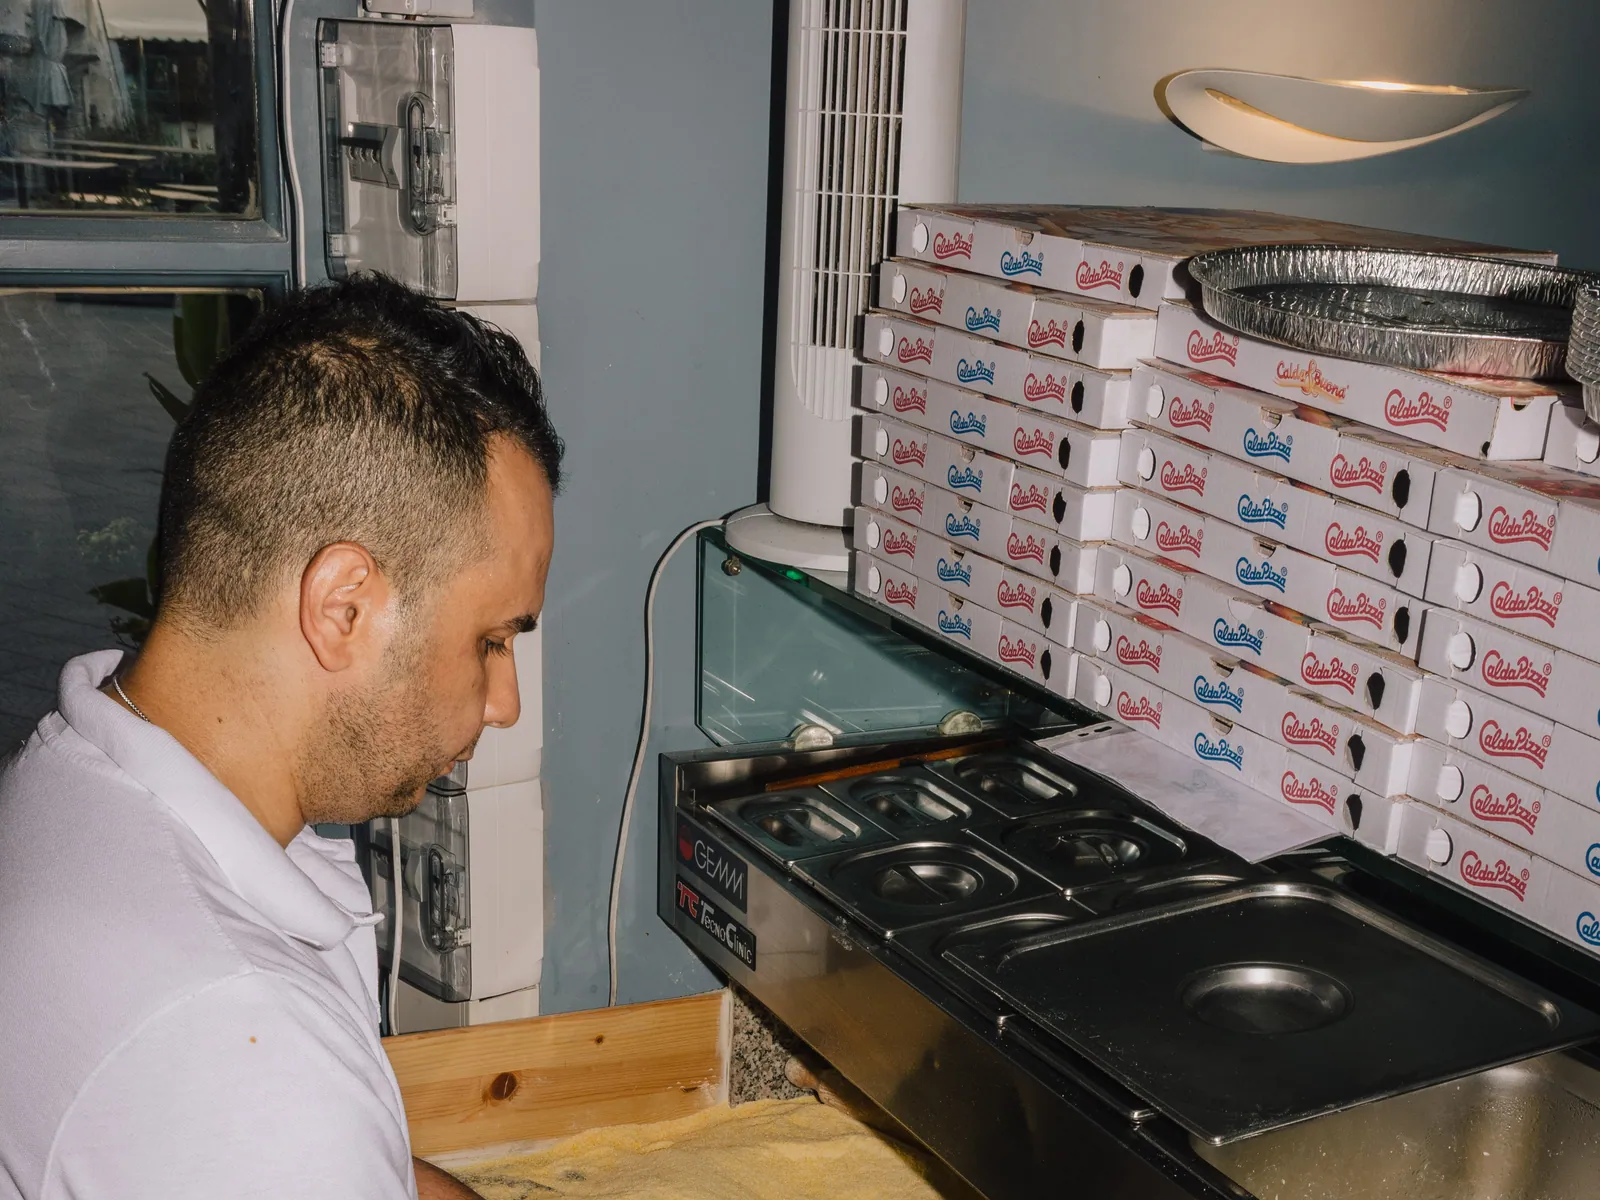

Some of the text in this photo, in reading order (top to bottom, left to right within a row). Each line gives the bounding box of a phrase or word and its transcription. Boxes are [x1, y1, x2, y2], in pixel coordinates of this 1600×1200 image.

[1276, 360, 1308, 381] Calda
[1313, 369, 1346, 400] Buona
[694, 839, 744, 900] GEMM
